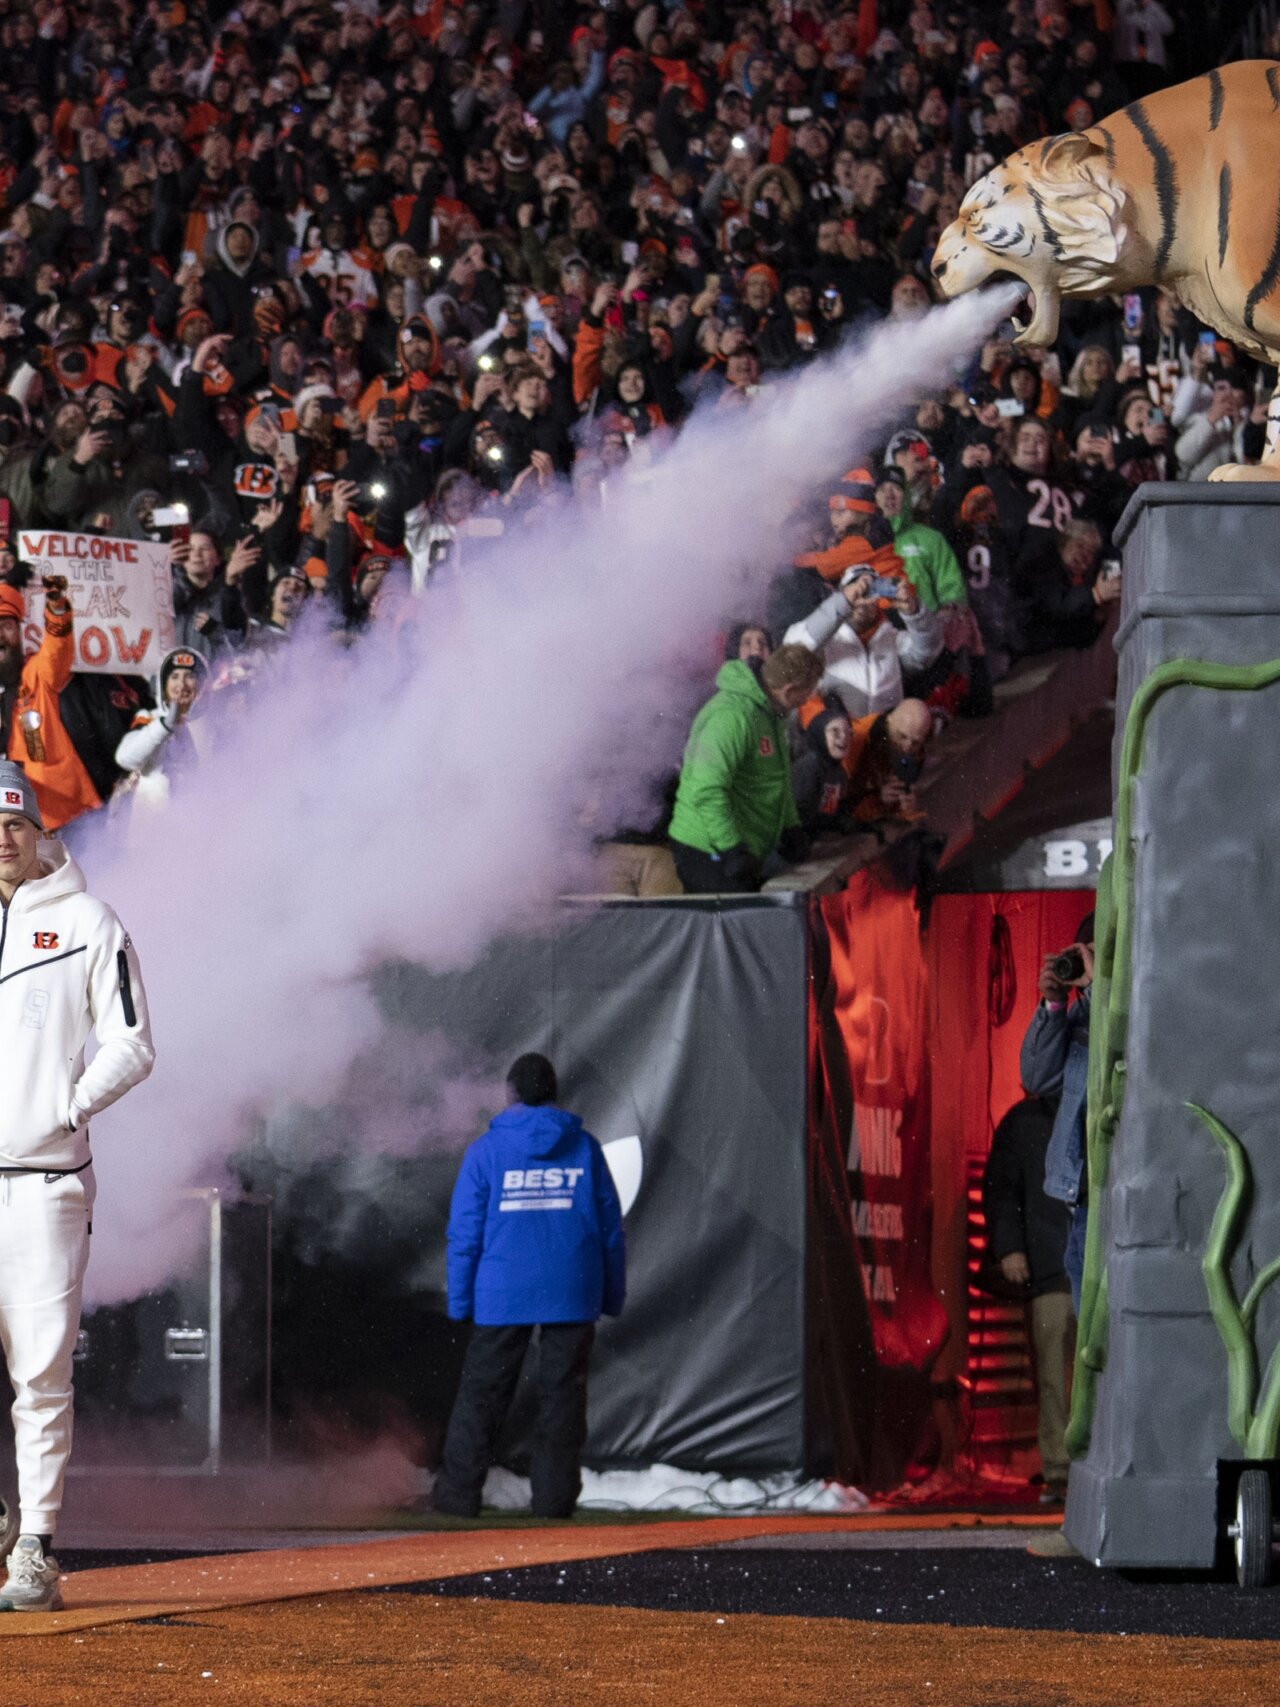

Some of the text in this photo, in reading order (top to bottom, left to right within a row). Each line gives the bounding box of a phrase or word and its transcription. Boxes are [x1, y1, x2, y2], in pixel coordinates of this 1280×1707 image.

[22, 534, 138, 563] WELCOME
[69, 560, 114, 582] THE
[967, 544, 991, 590] 9
[23, 584, 131, 619] FEAK
[23, 623, 153, 667] SOW
[503, 1167, 584, 1190] BEST
